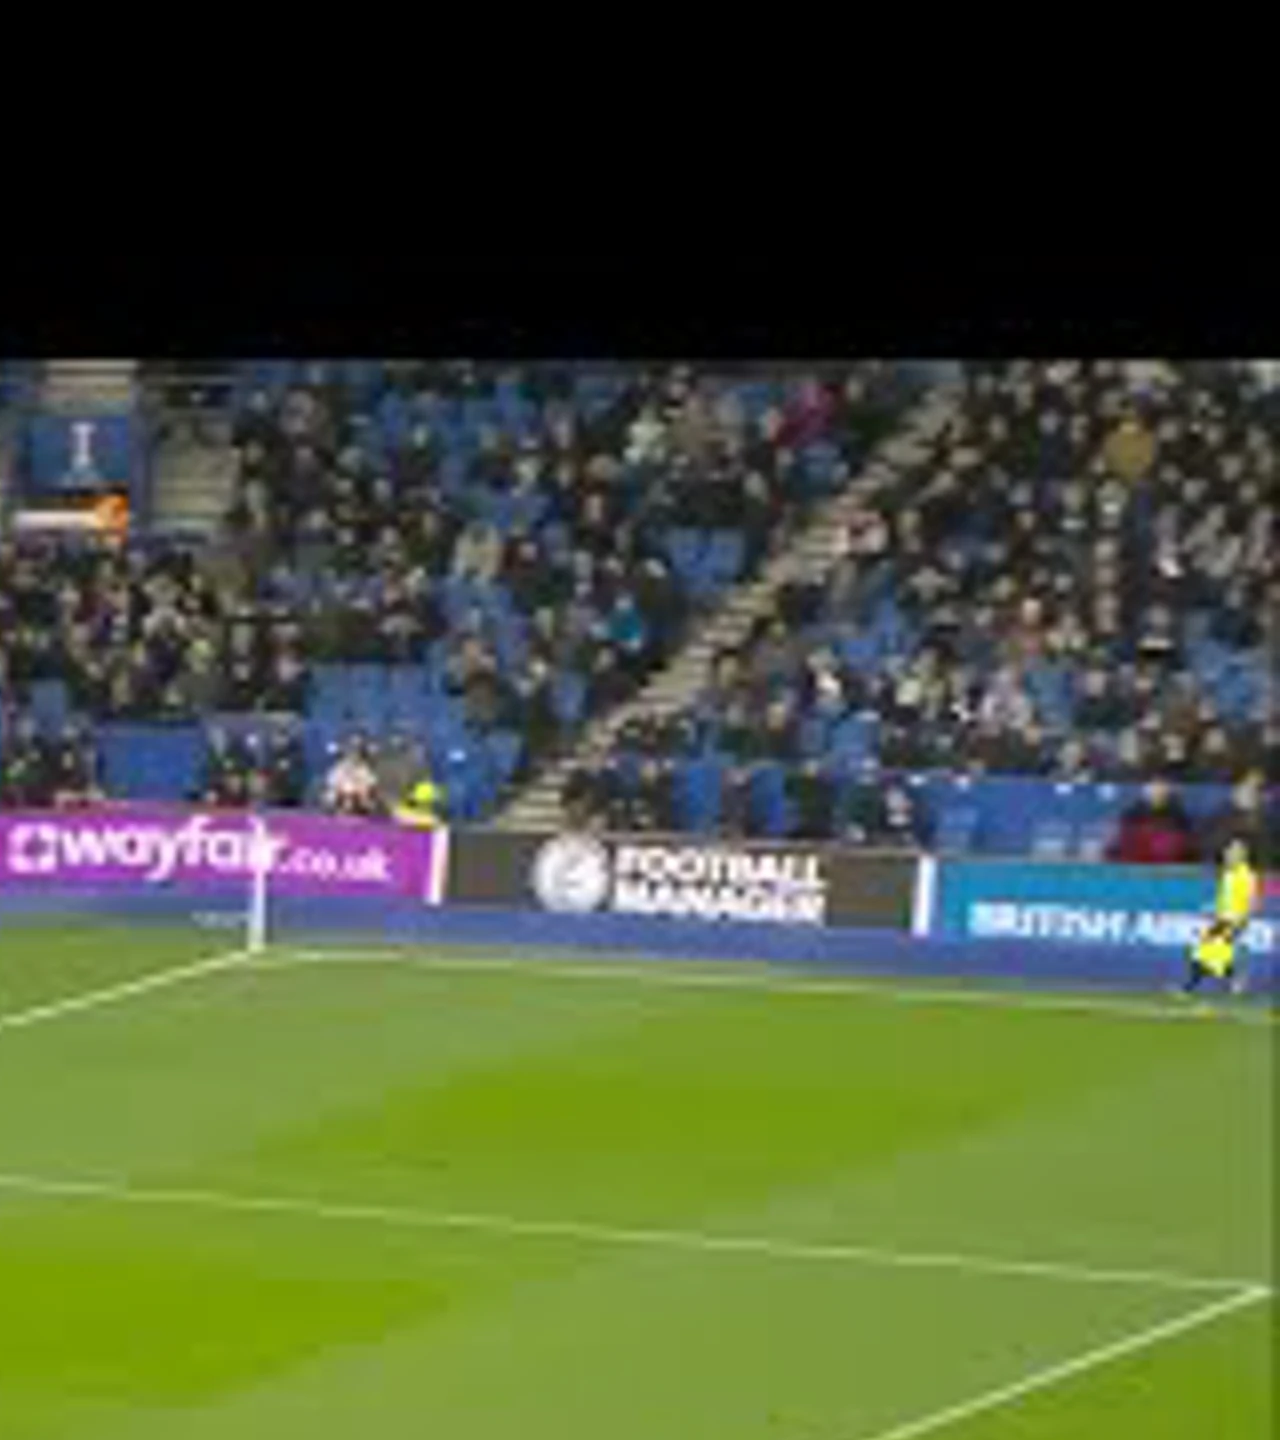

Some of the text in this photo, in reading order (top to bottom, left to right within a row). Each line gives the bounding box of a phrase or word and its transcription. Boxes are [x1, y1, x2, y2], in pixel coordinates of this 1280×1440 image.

[614, 845, 828, 888] FOOTBALL
[612, 881, 828, 926] MANAGER
[965, 899, 1131, 940] BRITISH
